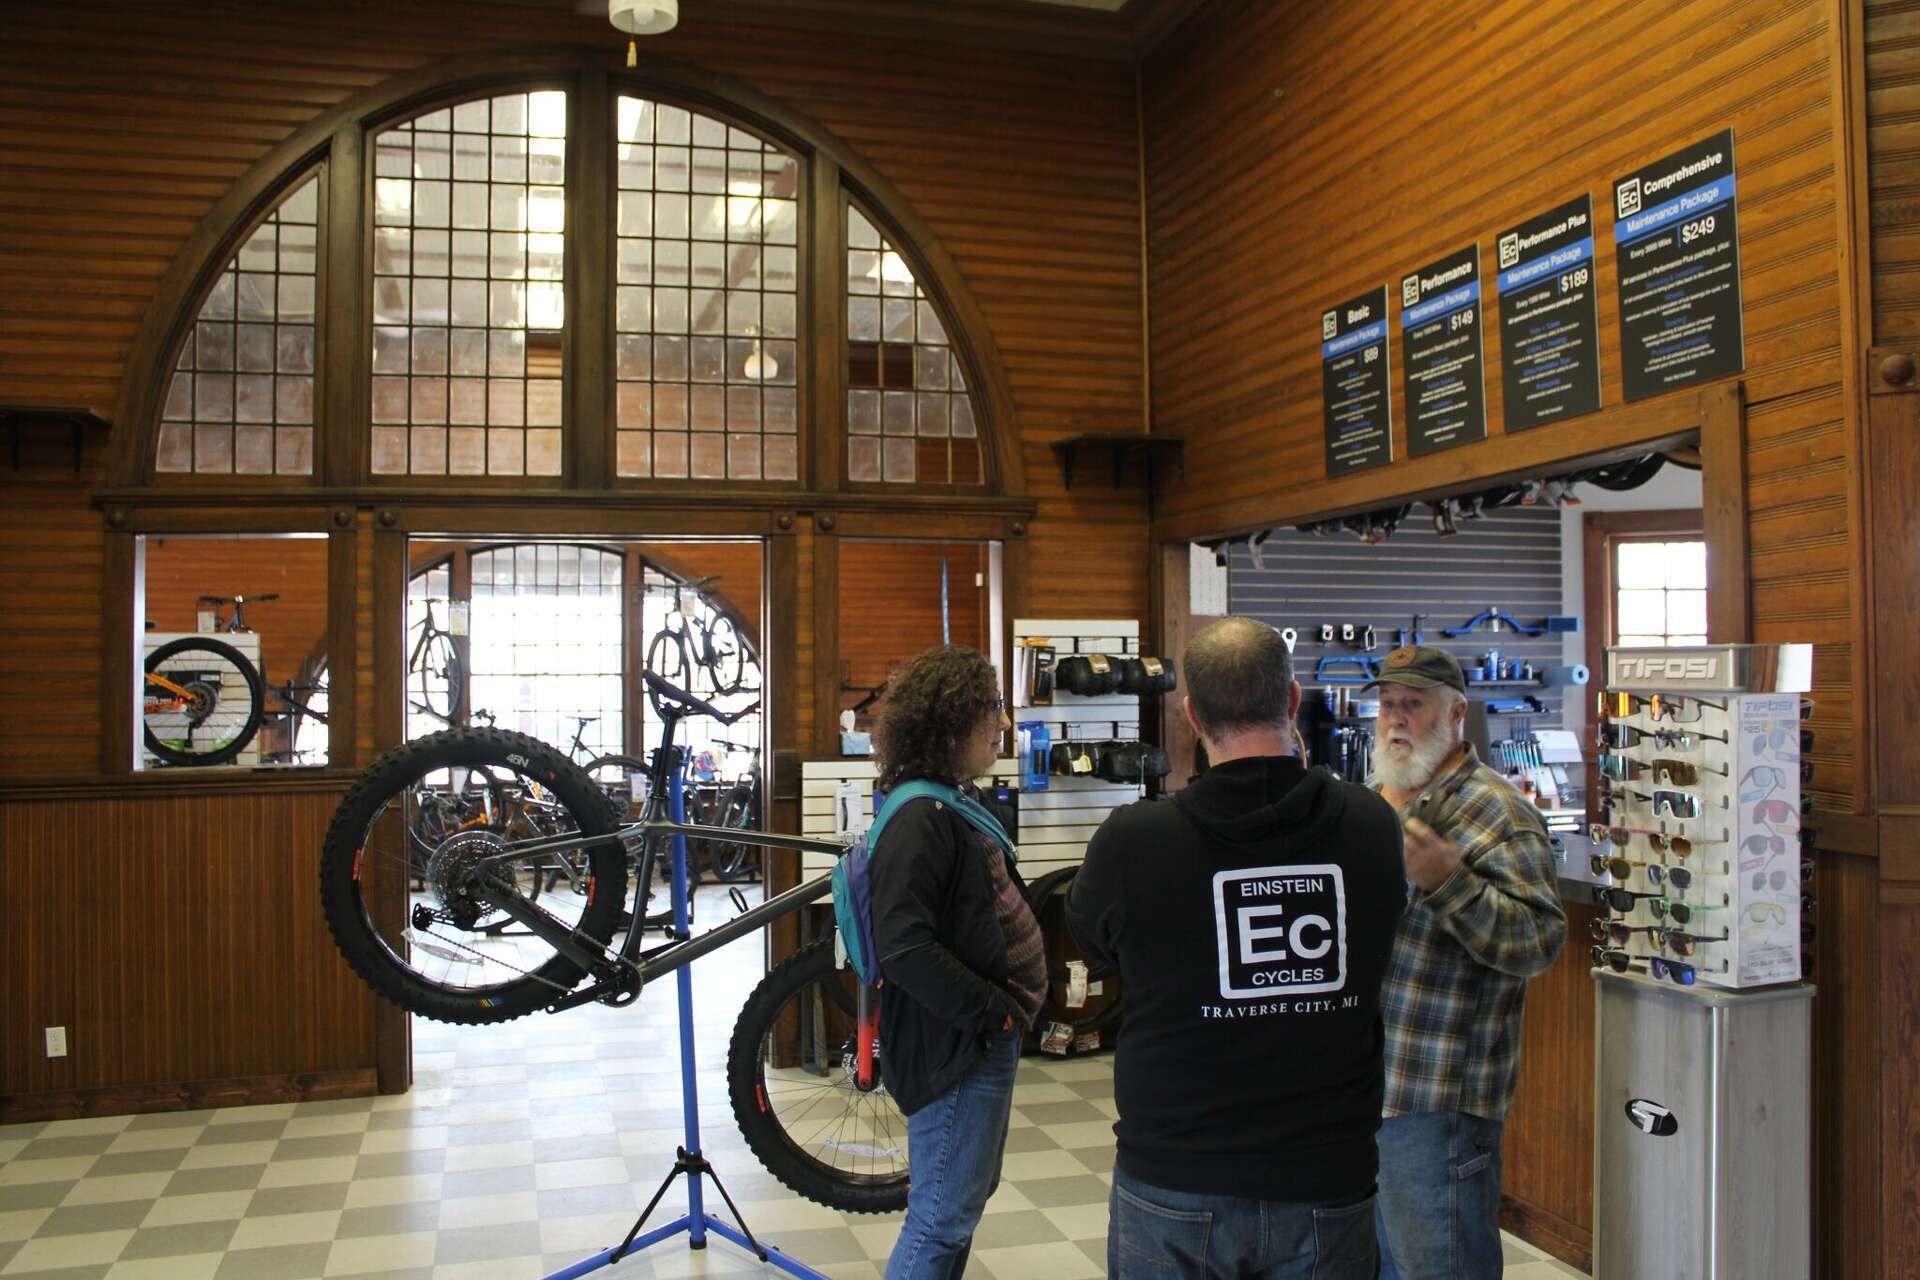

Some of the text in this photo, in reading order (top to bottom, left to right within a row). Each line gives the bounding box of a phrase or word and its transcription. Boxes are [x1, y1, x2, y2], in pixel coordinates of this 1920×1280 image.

[1643, 152, 1723, 196] Comprehensive
[1626, 187, 1719, 233] Maintenance Package
[1519, 213, 1587, 251] Performance Plus
[1682, 216, 1716, 245] $249
[1421, 261, 1473, 293] Performance
[1507, 247, 1582, 284] Maintenance Package
[1561, 268, 1589, 292] $189
[1347, 304, 1370, 324] Basic
[1451, 309, 1474, 331] $149
[1618, 657, 1717, 679] TIFOSI
[1240, 878, 1324, 897] EINSTEIN
[1237, 904, 1332, 964] Ec
[1252, 968, 1324, 985] CYCLES
[1201, 995, 1358, 1018] TRAVERSE CITY, MI
